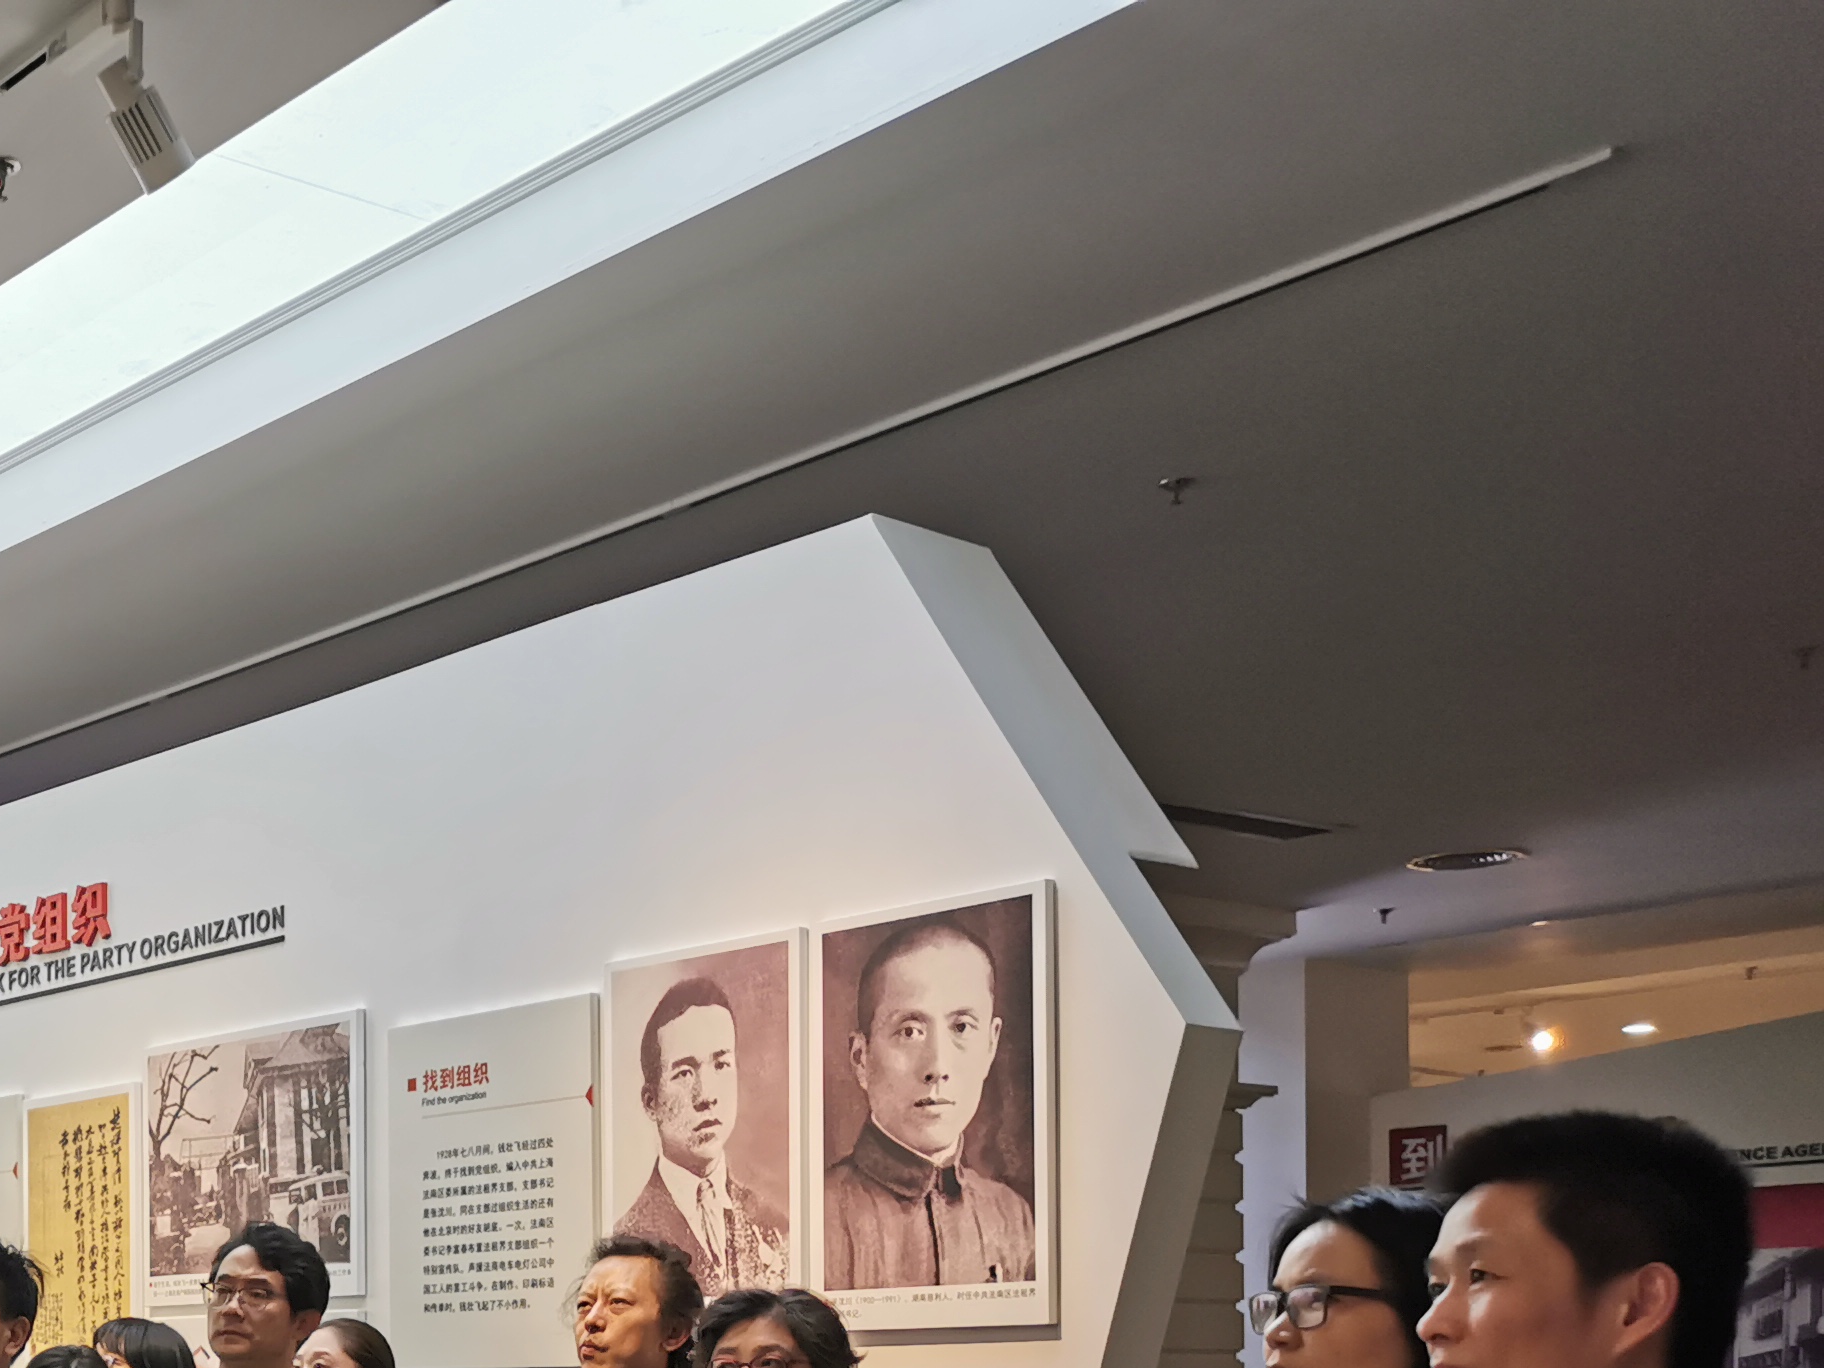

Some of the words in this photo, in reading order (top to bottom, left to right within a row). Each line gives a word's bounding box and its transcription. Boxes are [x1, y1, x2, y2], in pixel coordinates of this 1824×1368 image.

[9, 967, 41, 991] FOR
[45, 957, 76, 983] THE
[80, 941, 137, 976] PARTY
[140, 905, 286, 961] ORGANIZATION
[422, 1062, 490, 1093] 找到组织
[421, 1098, 436, 1107] Find
[437, 1096, 447, 1106] the
[448, 1091, 487, 1105] organization
[1781, 1143, 1824, 1158] AGE
